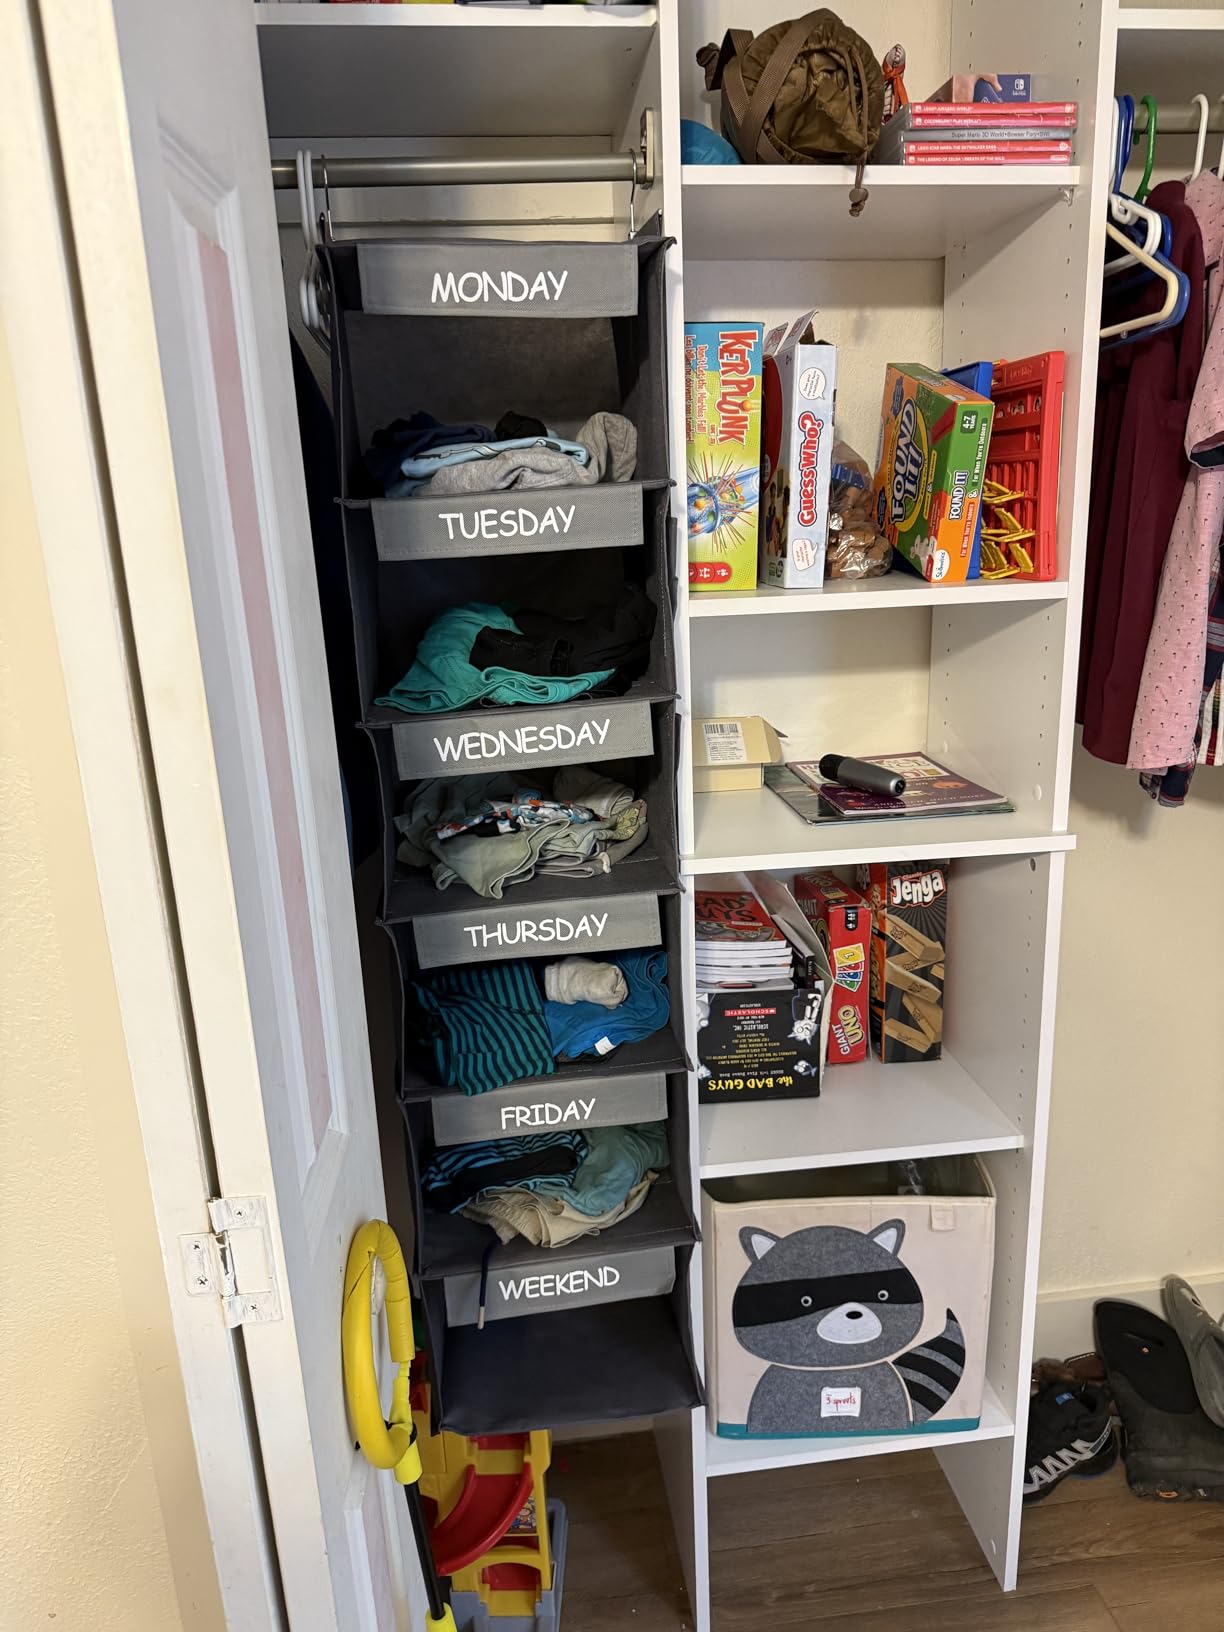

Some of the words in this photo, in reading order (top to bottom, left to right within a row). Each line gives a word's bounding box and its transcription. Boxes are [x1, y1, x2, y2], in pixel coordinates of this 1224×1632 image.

[431, 270, 569, 304] MONDAY
[698, 366, 707, 378] Let
[698, 379, 706, 390] the
[696, 392, 707, 417] Marbles
[963, 416, 971, 429] 4-7
[978, 423, 987, 444] Outdoors
[891, 402, 915, 521] FOUND
[904, 445, 922, 500] IT!
[955, 472, 968, 484] IT!
[950, 487, 964, 519] FOUND
[968, 490, 977, 498] &
[438, 504, 576, 540] TUESDAY
[433, 718, 611, 762] WEDNESDAY
[892, 872, 944, 904] Jenga
[463, 912, 609, 948] THURSDAY
[832, 1024, 850, 1055] GIANT
[838, 1004, 865, 1046] UNO
[708, 1079, 744, 1090] GUYS
[747, 1078, 773, 1088] BAD
[776, 1076, 793, 1086] the
[500, 1097, 596, 1130] FRIDAY
[498, 1265, 620, 1301] WEEKEND
[833, 1392, 856, 1412] sprouts
